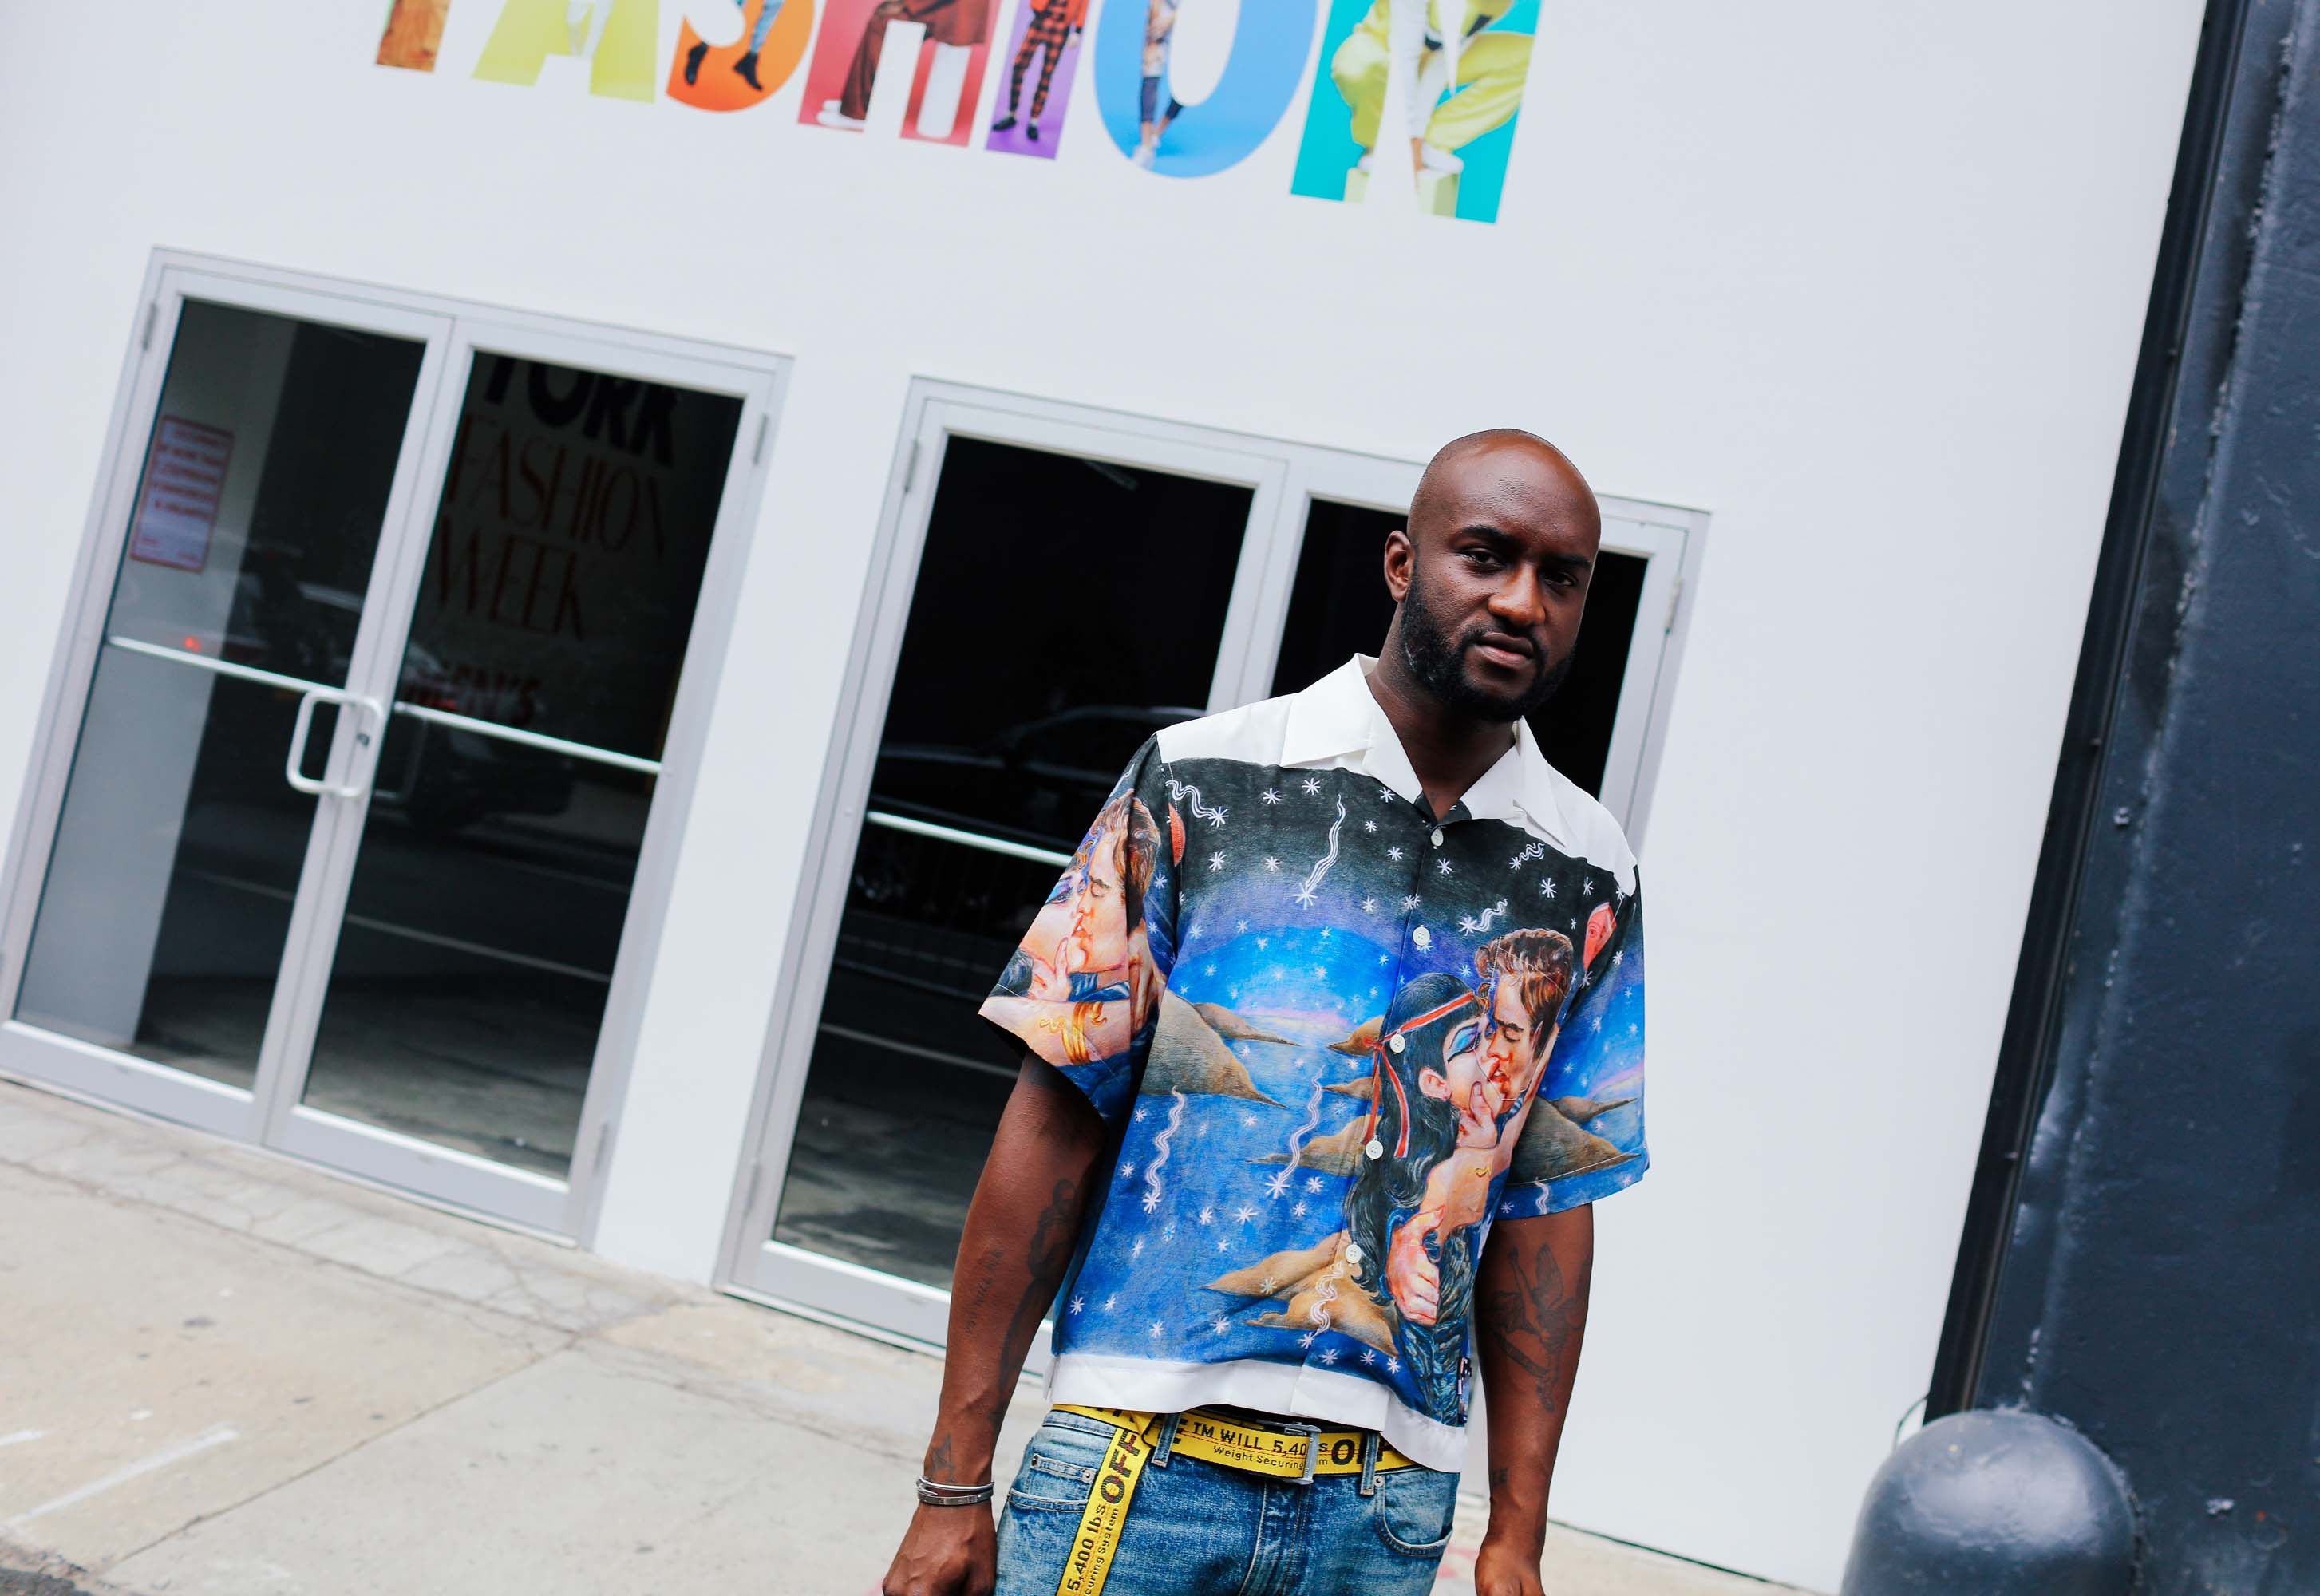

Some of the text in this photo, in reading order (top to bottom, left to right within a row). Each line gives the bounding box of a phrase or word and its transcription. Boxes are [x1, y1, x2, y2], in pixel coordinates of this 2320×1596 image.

[1213, 1445, 1253, 1462] Weight
[1256, 1455, 1305, 1471] Securing
[1220, 1429, 1263, 1450] WILL
[1273, 1440, 1309, 1456] 5,40
[1067, 1539, 1094, 1591] 5,400
[1086, 1503, 1106, 1533] lbs
[1101, 1429, 1141, 1504] OFF
[1098, 1508, 1119, 1552] System
